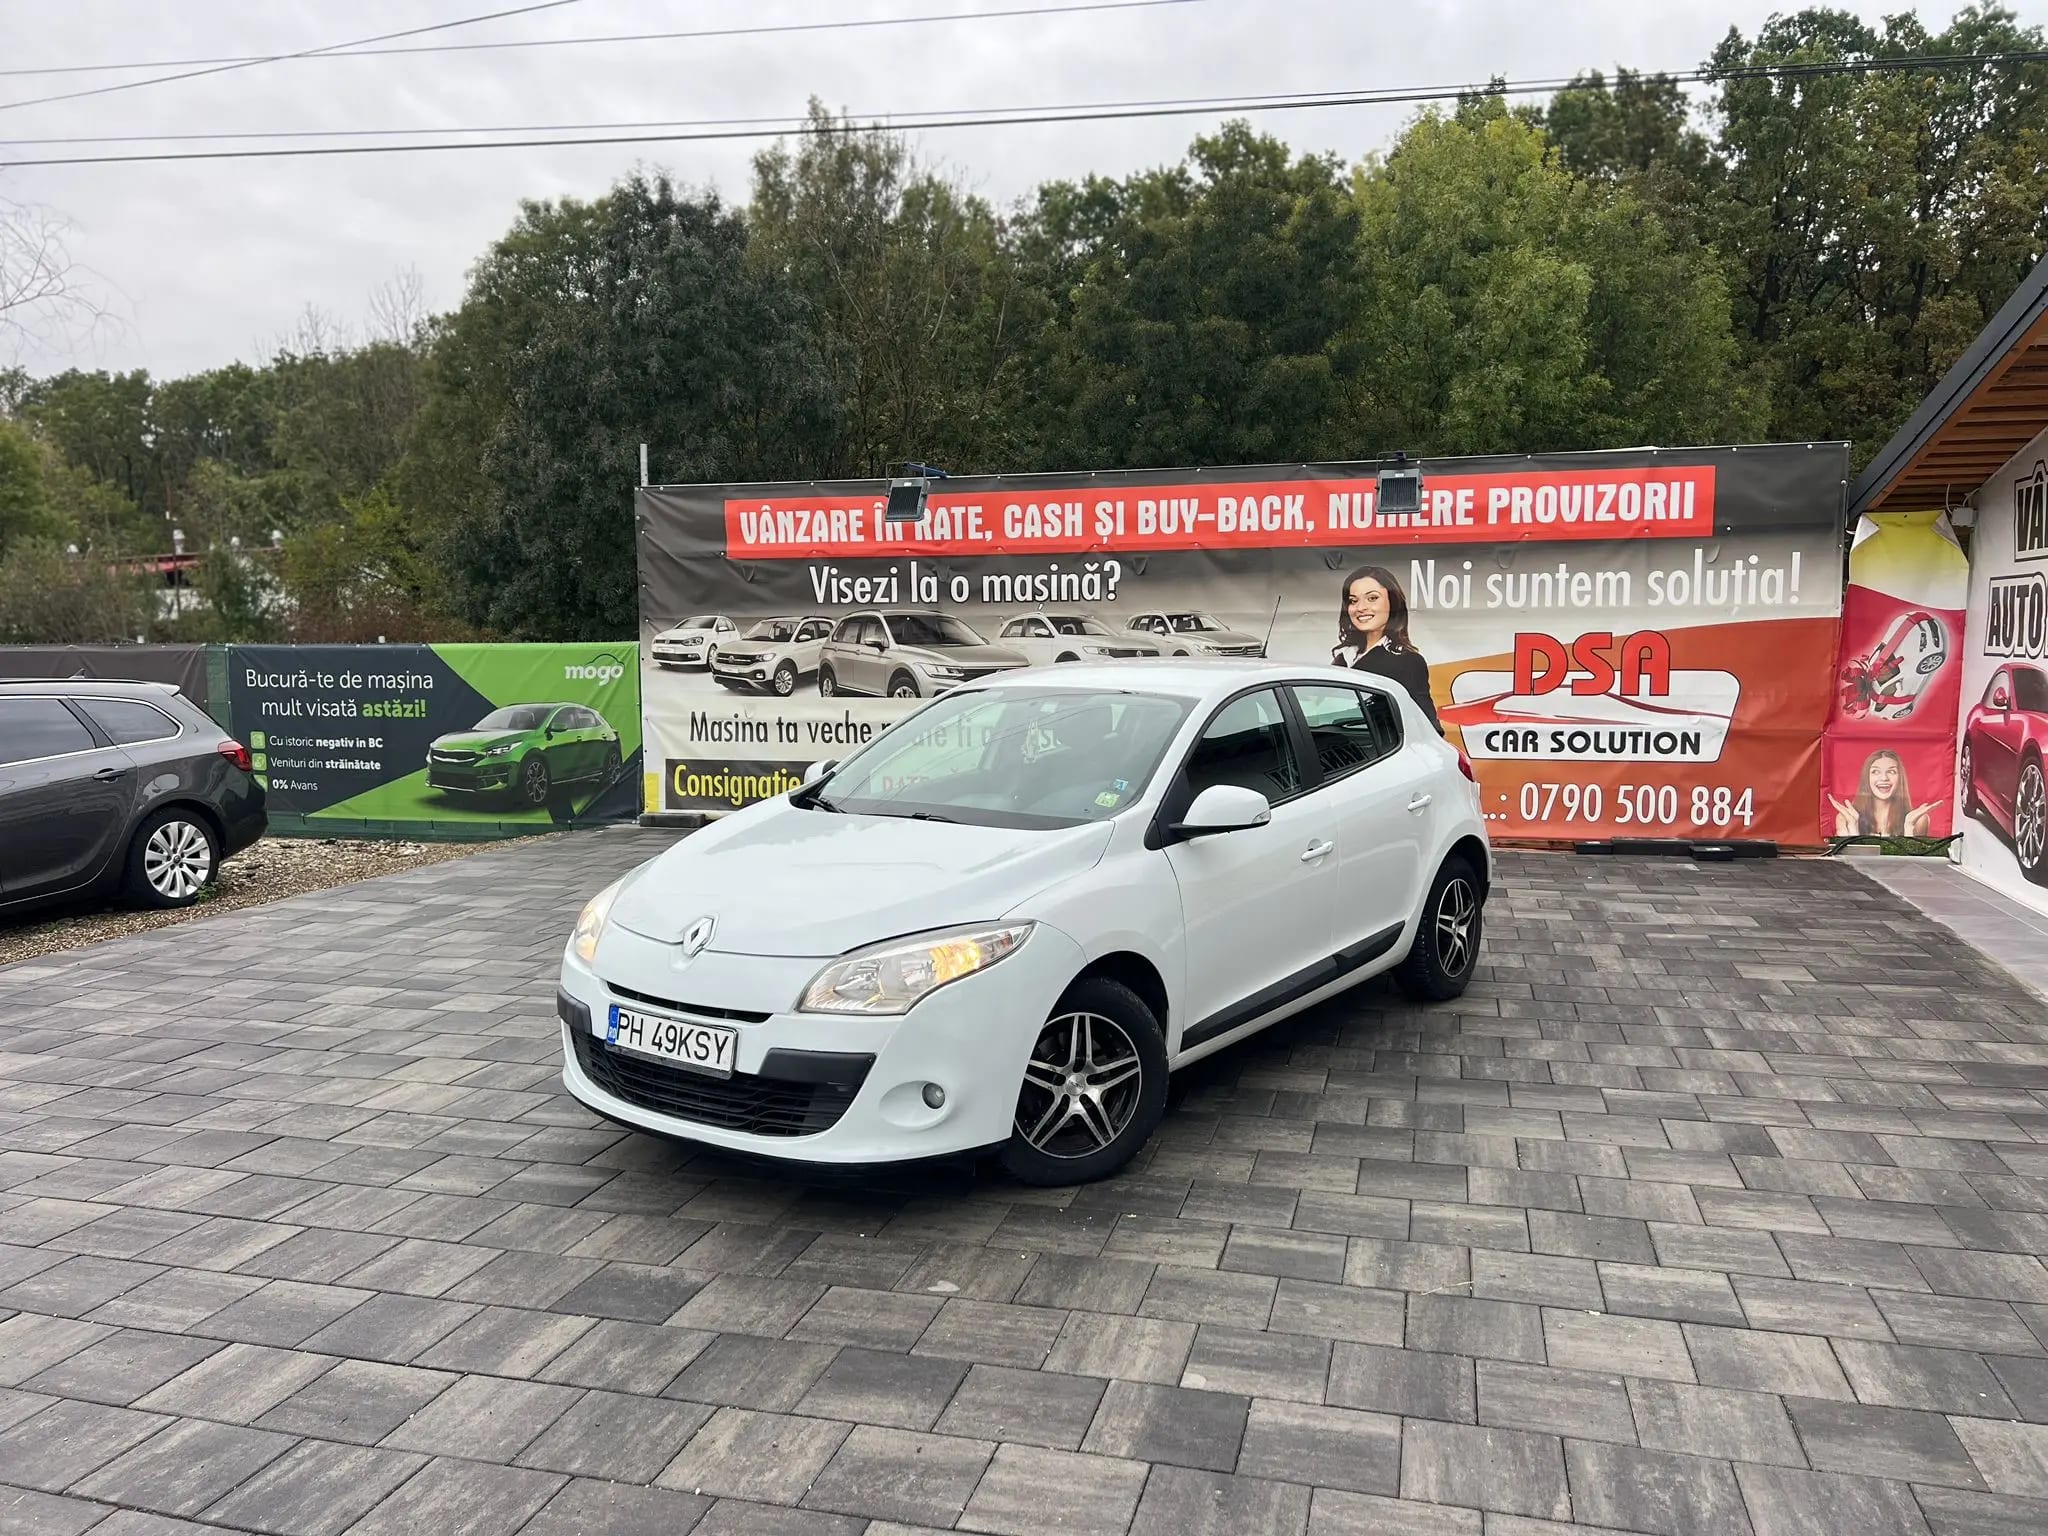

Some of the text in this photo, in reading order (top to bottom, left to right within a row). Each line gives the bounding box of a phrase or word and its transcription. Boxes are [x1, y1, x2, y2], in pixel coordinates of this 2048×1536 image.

[739, 505, 864, 544] VÂNZARE
[914, 506, 992, 542] RATE,
[1003, 502, 1083, 539] CASH
[1095, 500, 1125, 545] ȘI
[1137, 494, 1315, 535] BUY-BACK,
[1487, 481, 1694, 525] PROVIZORII
[2017, 471, 2048, 552] VÂ
[809, 560, 1121, 610] Visezi la o mașină?
[1410, 548, 1800, 615] Noi suntem soluția!
[564, 665, 624, 687] mogo
[1513, 629, 1670, 697] DSA
[246, 669, 434, 694] Bucură-te de mașina
[262, 698, 426, 718] mult visată astăzi!
[269, 735, 283, 746] Cu
[285, 736, 314, 747] istoric
[315, 737, 354, 749] negativ
[368, 738, 383, 748] BC
[776, 716, 798, 743] ta
[807, 710, 872, 744] veche
[1484, 729, 1700, 755] CAR SOLUTION
[270, 757, 381, 770] Venituri din străinătate
[272, 779, 318, 791] 0% Avans
[1519, 782, 1602, 822] 0790
[1615, 784, 1677, 824] 500
[1690, 786, 1754, 827] 884
[617, 1012, 643, 1046] PH
[651, 1022, 729, 1064] 49KSY
